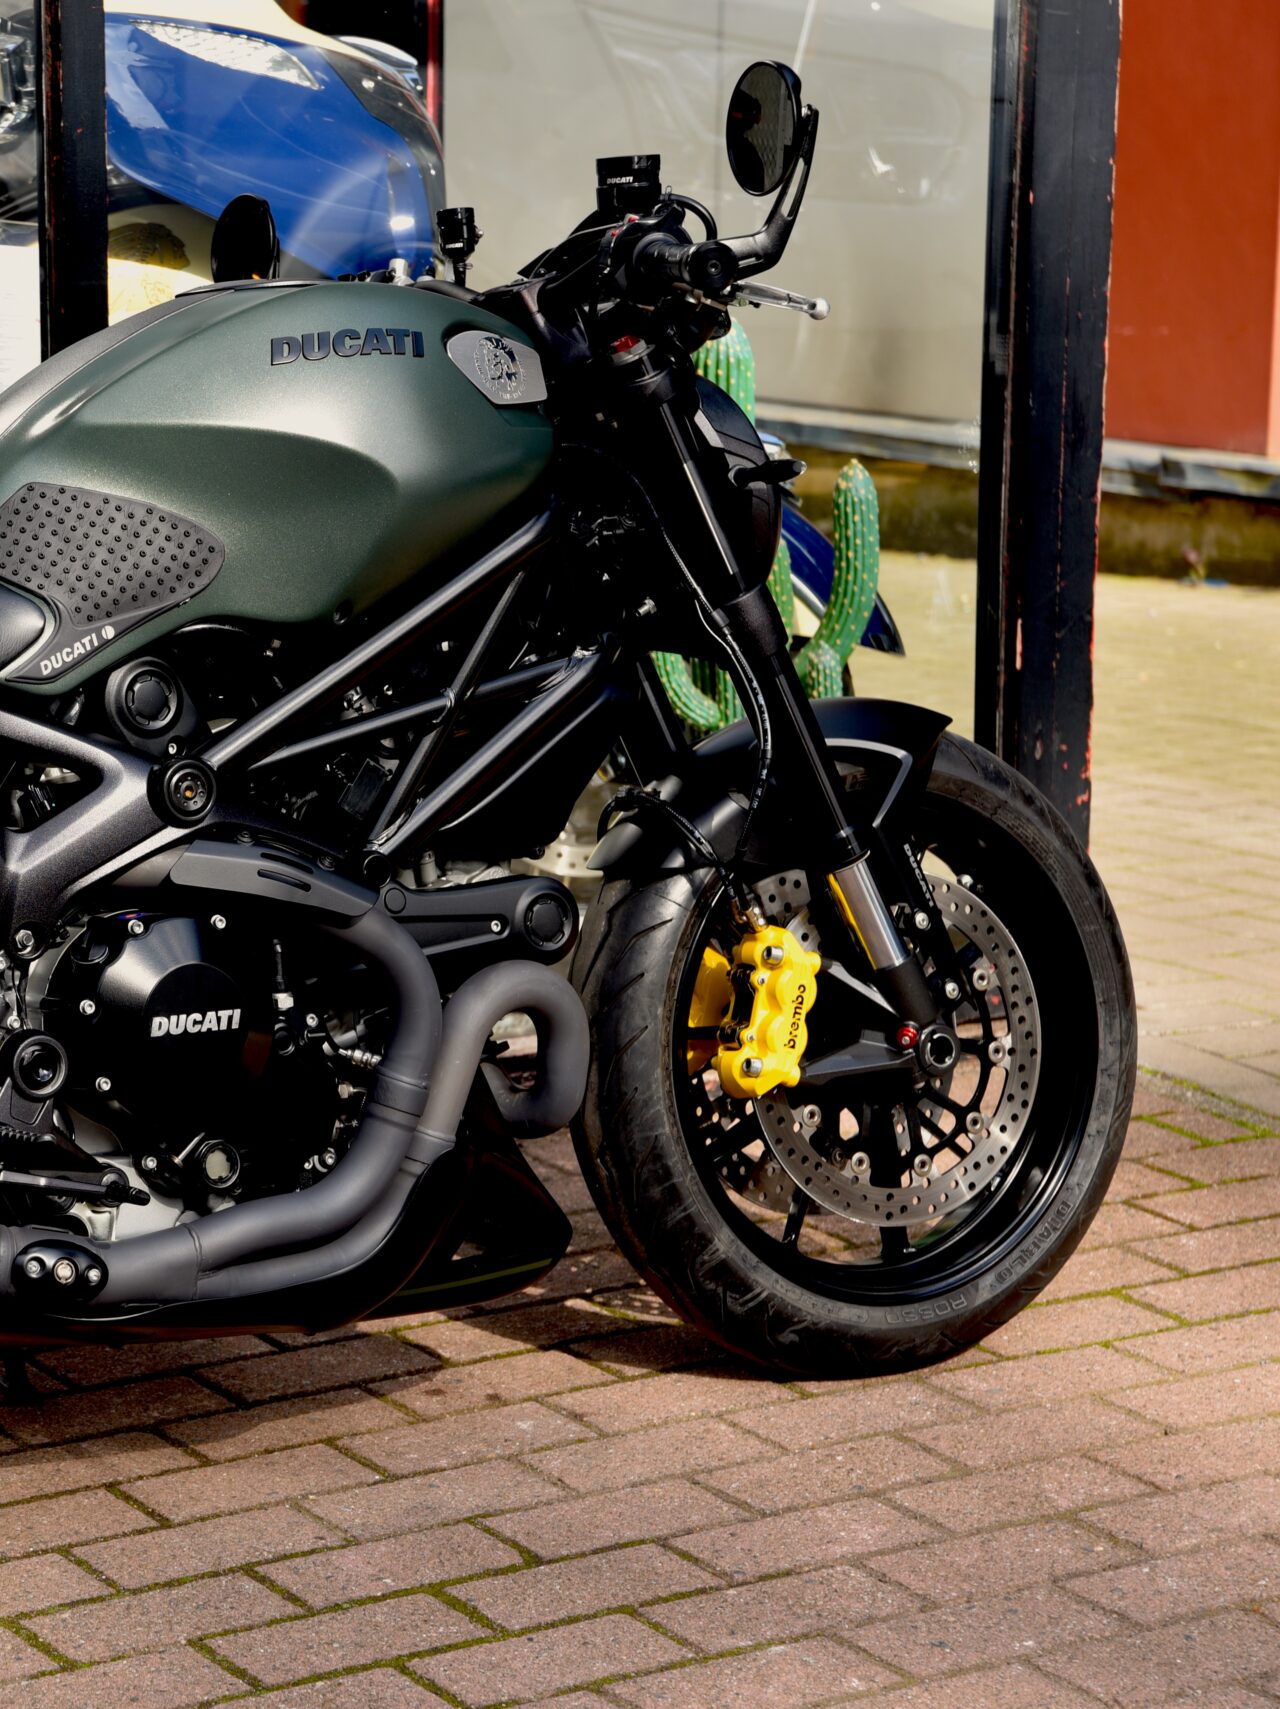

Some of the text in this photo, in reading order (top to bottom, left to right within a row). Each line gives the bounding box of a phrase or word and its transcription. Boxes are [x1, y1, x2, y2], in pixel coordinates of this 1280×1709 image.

[607, 176, 633, 184] DUCATI
[270, 327, 425, 366] DUCATI
[40, 635, 99, 676] DUCATI
[904, 843, 935, 907] DUCATI
[150, 1008, 242, 1038] DUCATI
[784, 983, 807, 1050] brembo
[995, 1200, 1073, 1285] DIABLO
[884, 1292, 968, 1324] ROSSO
